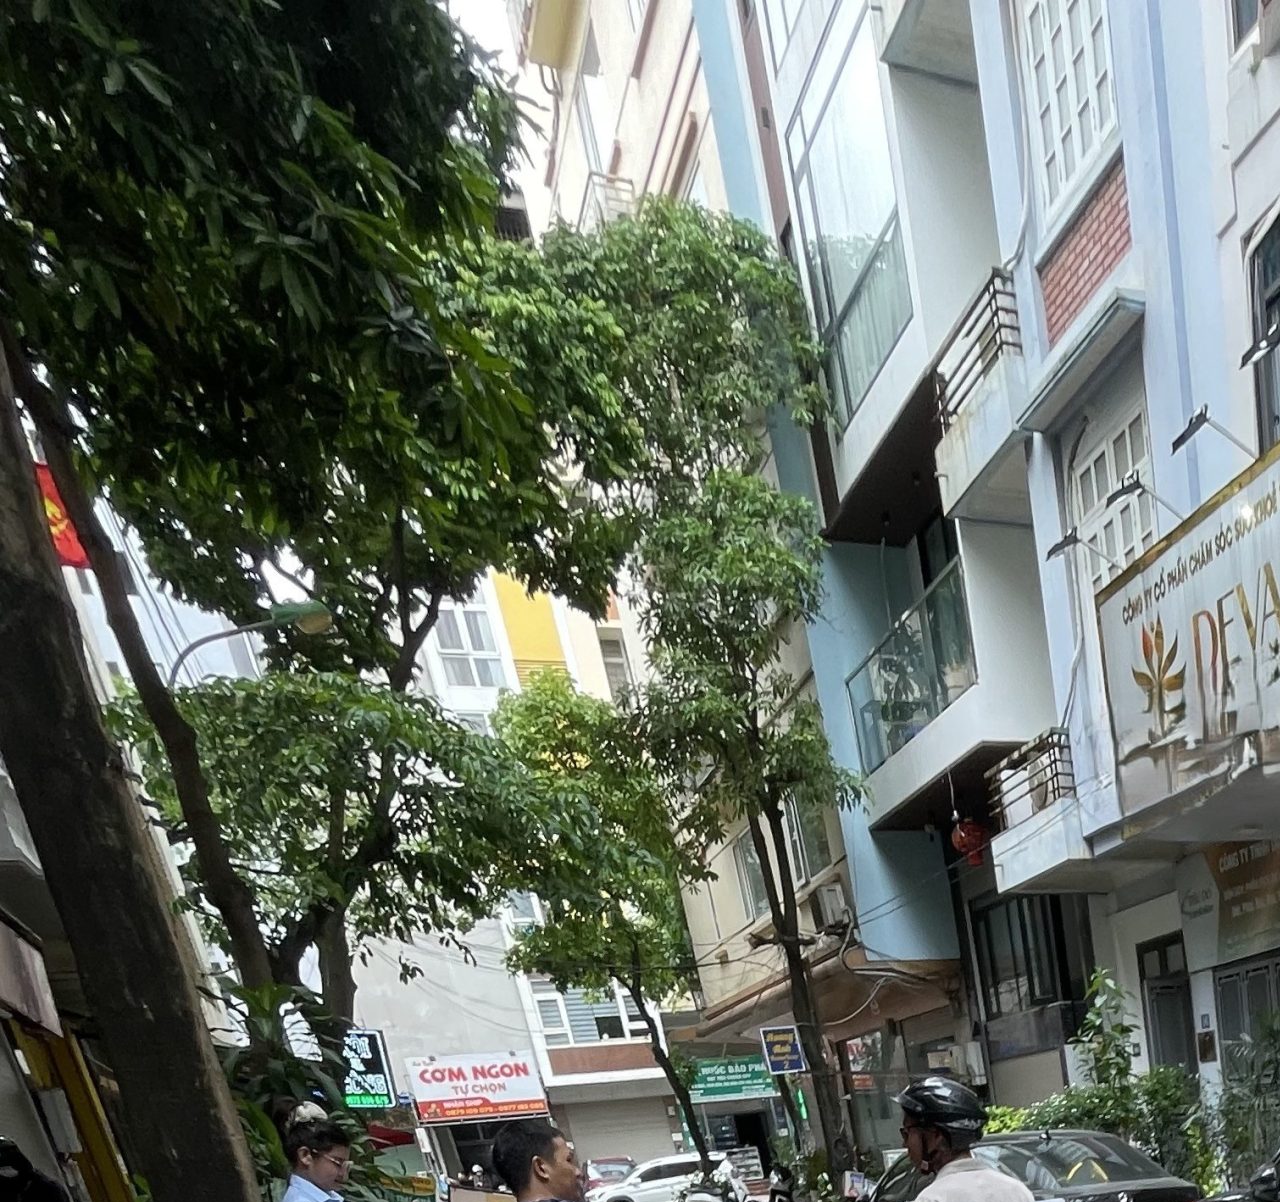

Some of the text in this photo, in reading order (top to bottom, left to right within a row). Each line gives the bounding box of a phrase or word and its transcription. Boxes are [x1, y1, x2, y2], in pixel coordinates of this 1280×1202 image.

[1122, 592, 1143, 625] CÔNG
[1144, 586, 1153, 610] TY
[1214, 522, 1233, 557] SÓC
[419, 1062, 530, 1084] CƠM NGON
[452, 1082, 507, 1096] TỰ CHỌN
